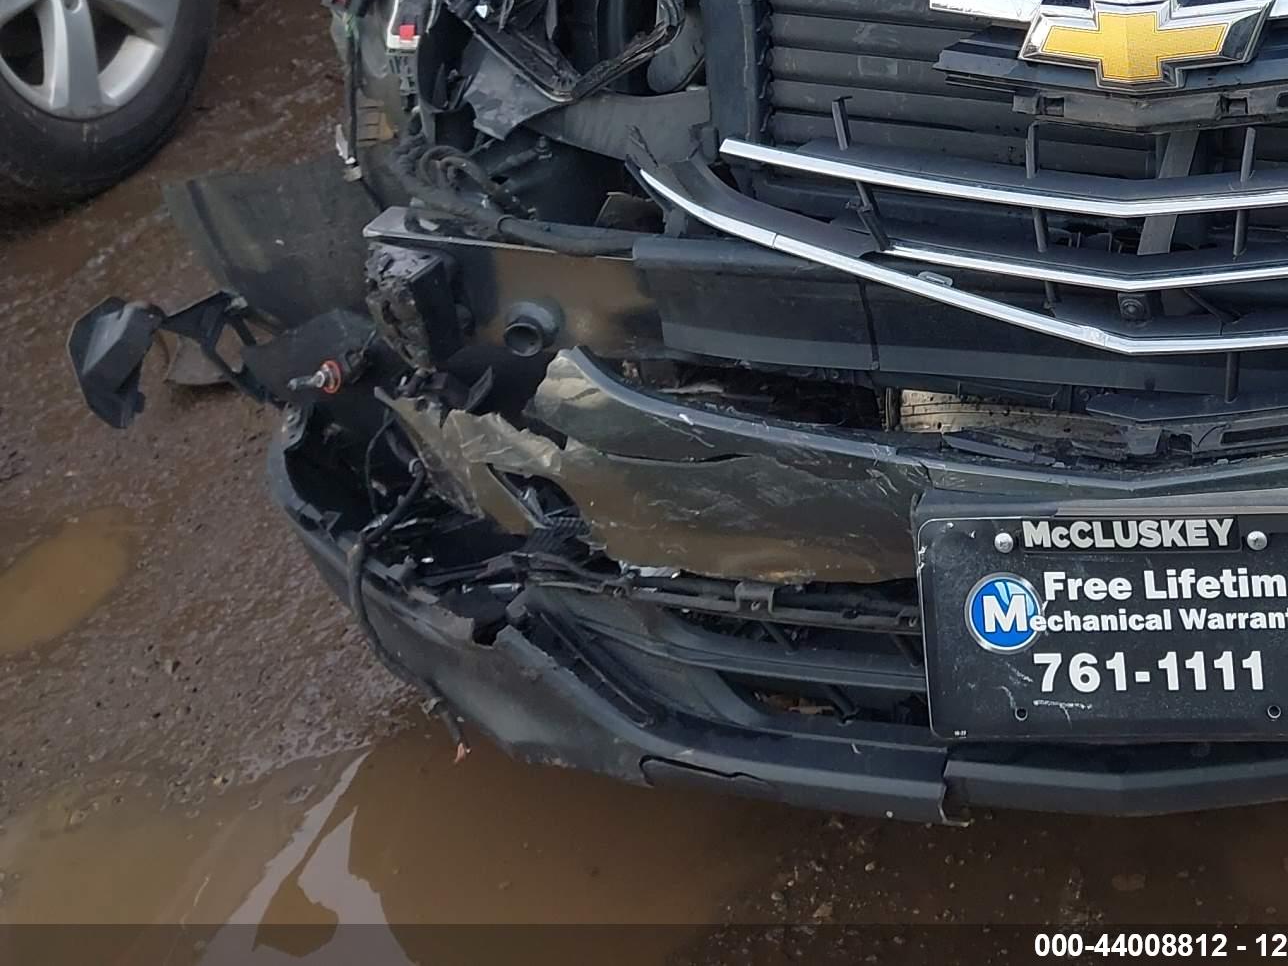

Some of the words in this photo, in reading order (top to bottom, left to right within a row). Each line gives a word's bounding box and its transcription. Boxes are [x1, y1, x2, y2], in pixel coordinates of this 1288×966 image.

[1022, 519, 1234, 548] McCLUSKEY
[1043, 570, 1133, 602] Free
[1032, 650, 1265, 694] 761-1111
